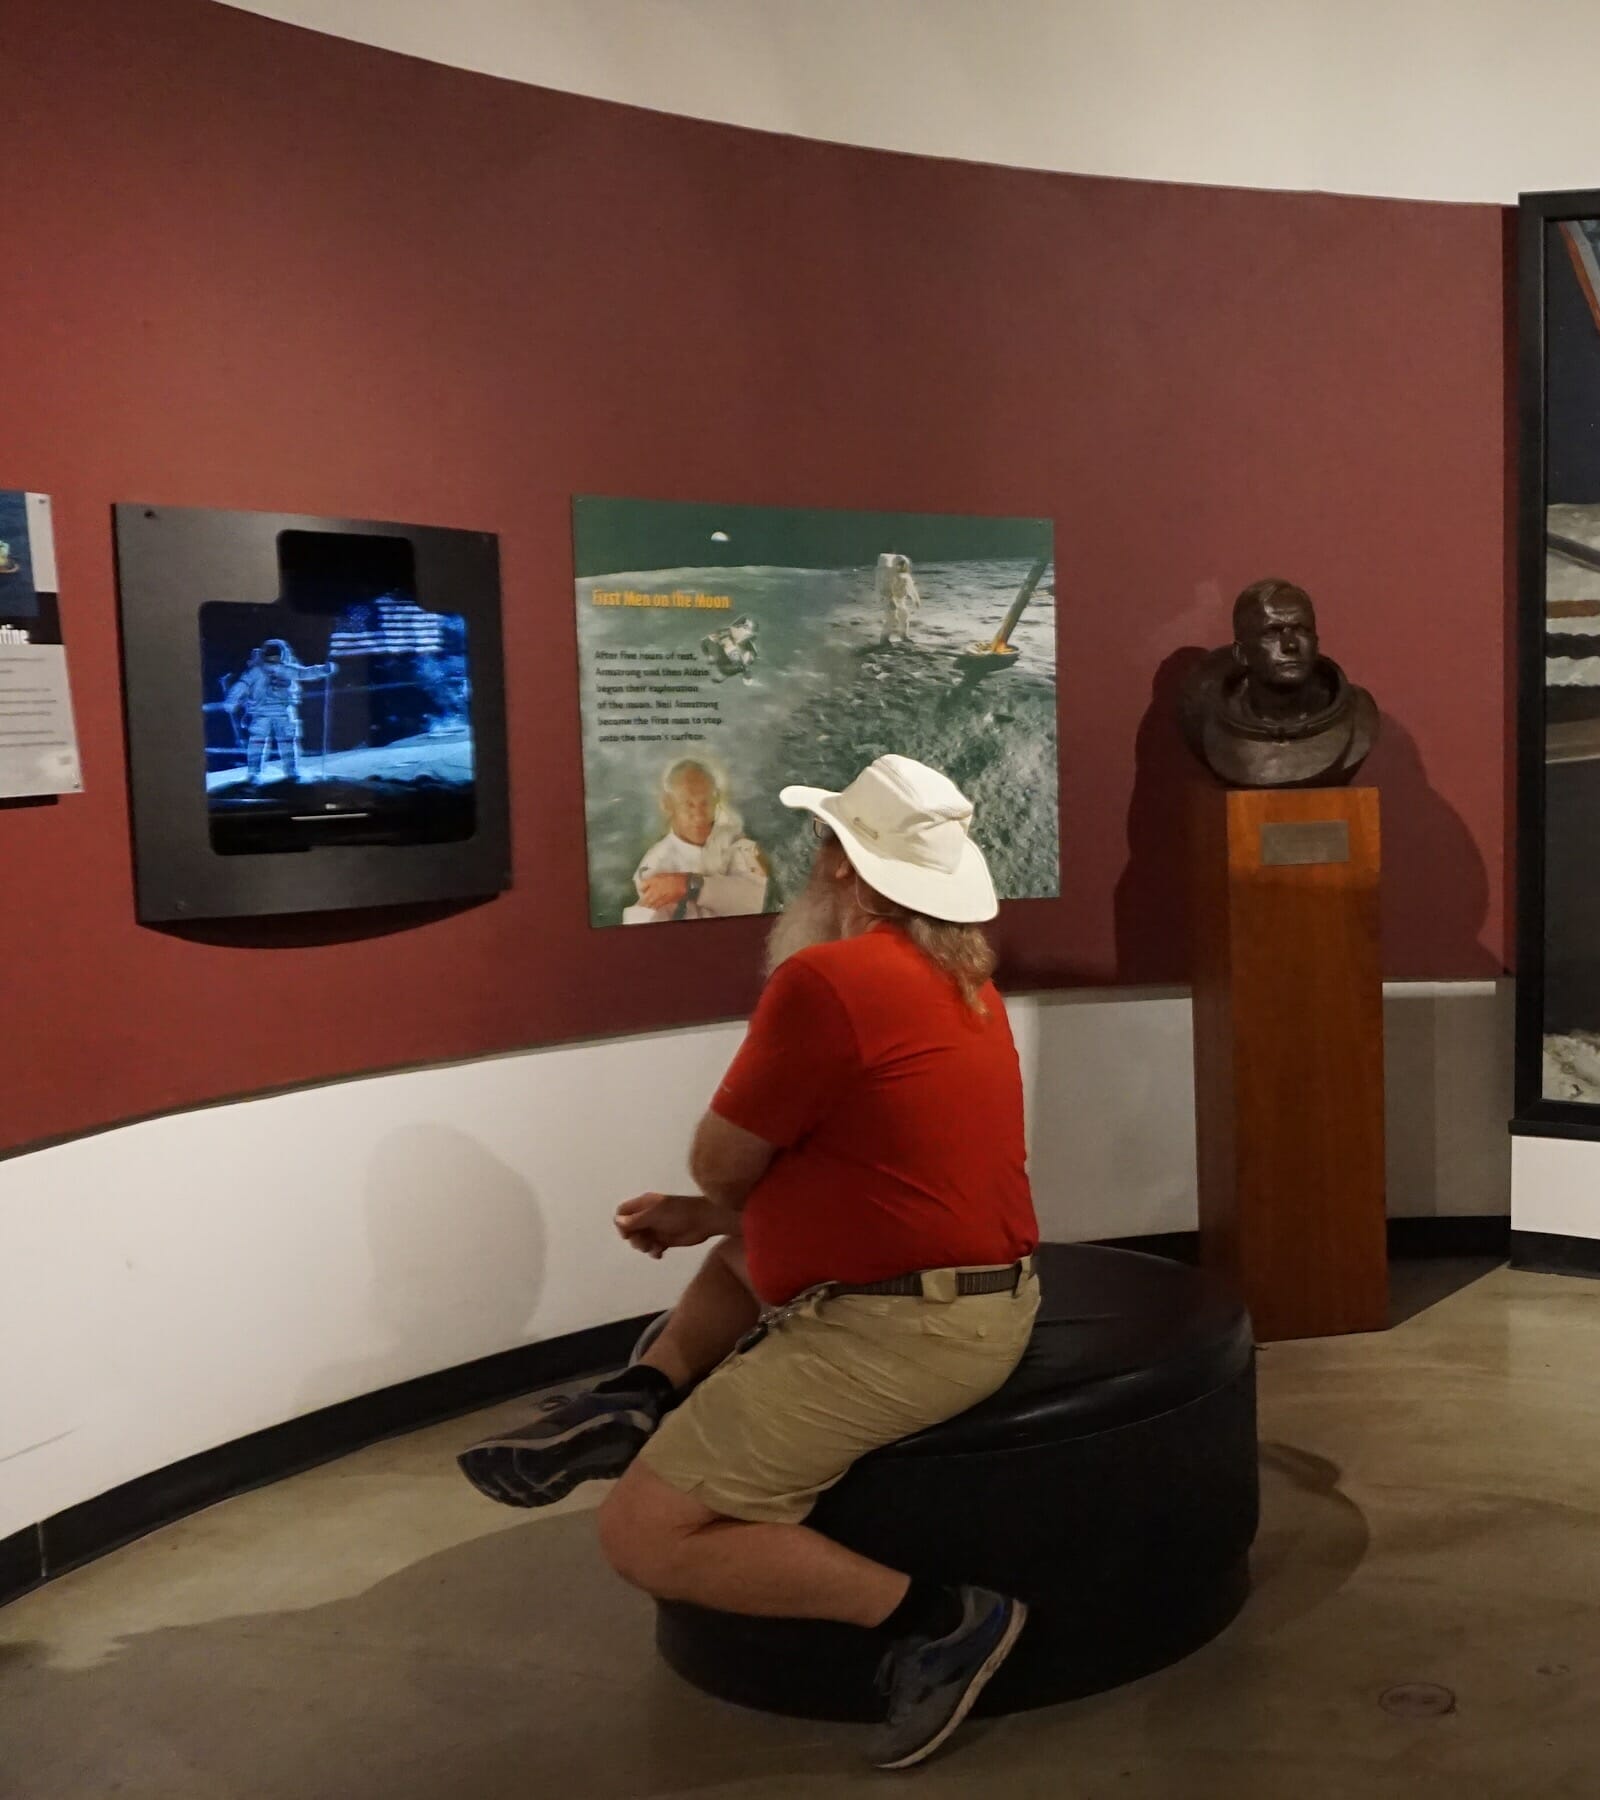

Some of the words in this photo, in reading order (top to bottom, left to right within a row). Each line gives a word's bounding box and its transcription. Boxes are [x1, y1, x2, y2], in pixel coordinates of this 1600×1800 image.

[653, 594, 670, 608] on
[695, 592, 730, 609] Moon
[0, 624, 29, 645] tine
